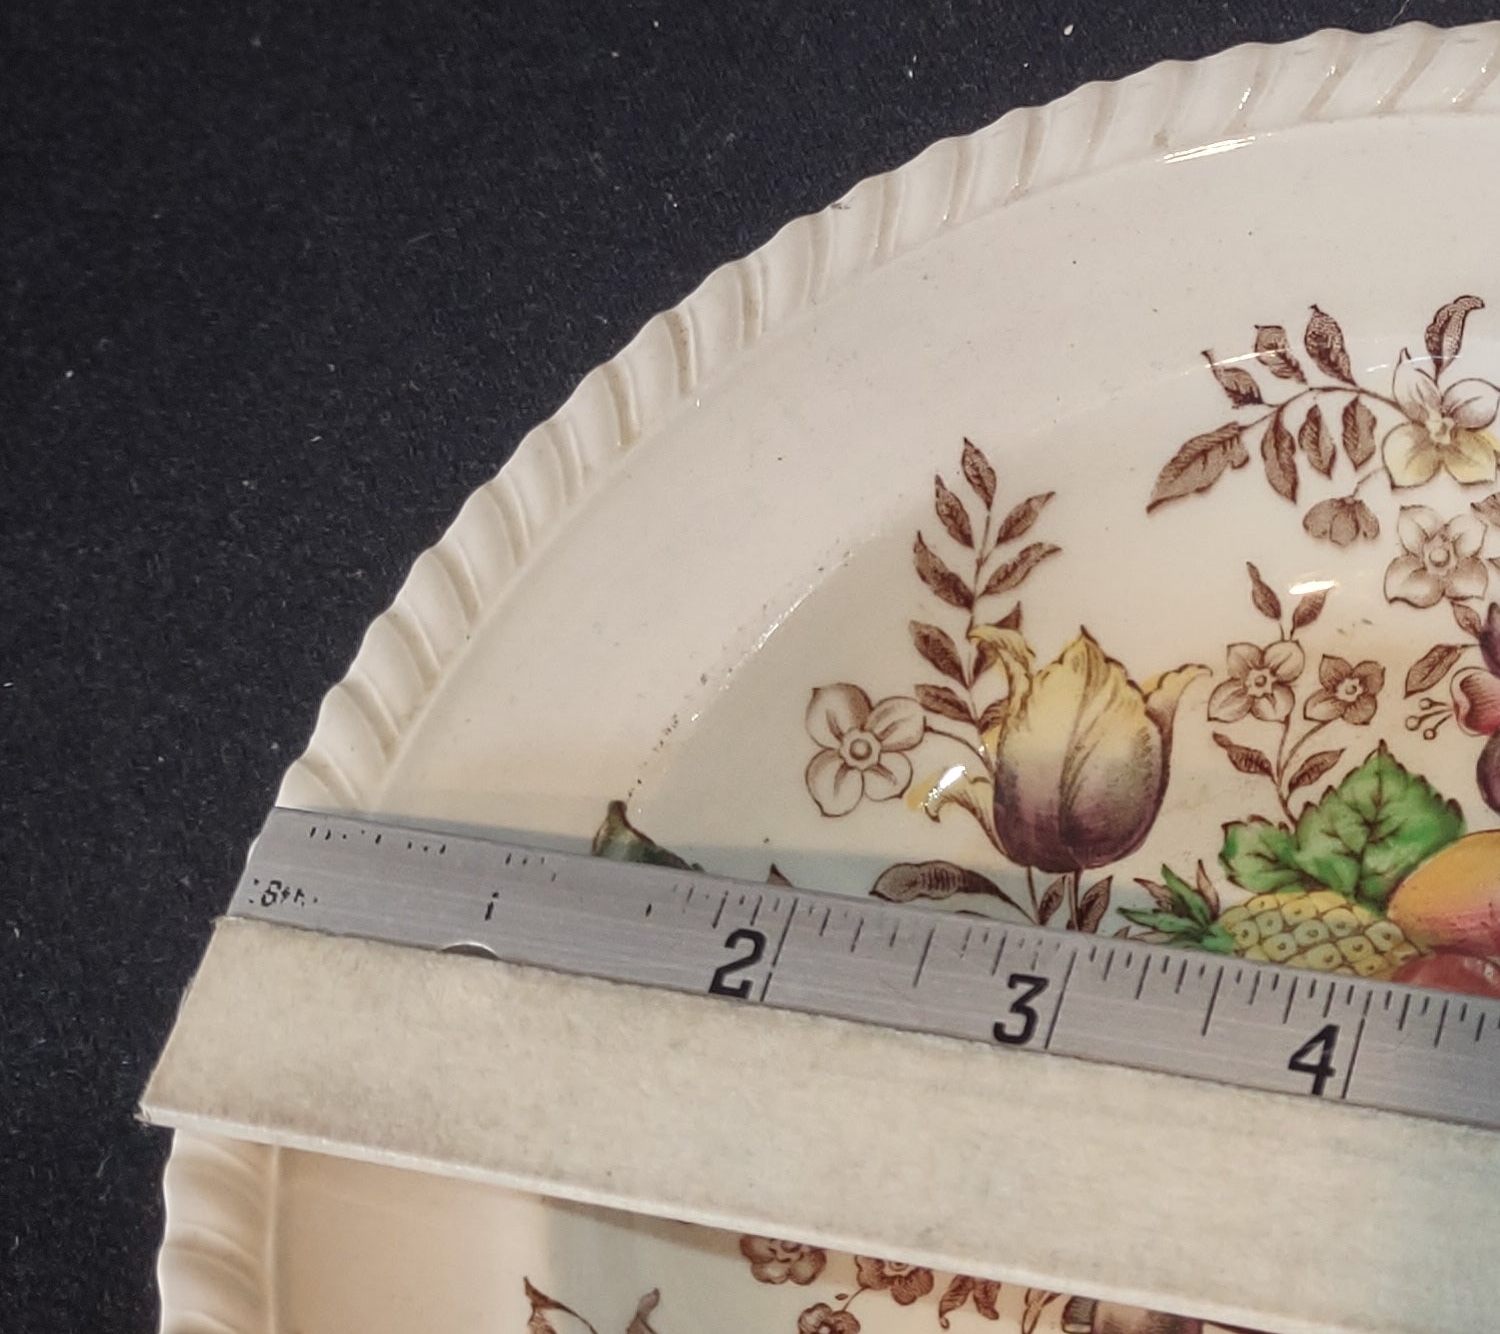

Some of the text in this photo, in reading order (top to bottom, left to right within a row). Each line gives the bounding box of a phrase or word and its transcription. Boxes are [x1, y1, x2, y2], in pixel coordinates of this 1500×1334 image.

[708, 928, 767, 1000] 2
[993, 973, 1050, 1045] 3
[1287, 1023, 1341, 1096] 4
